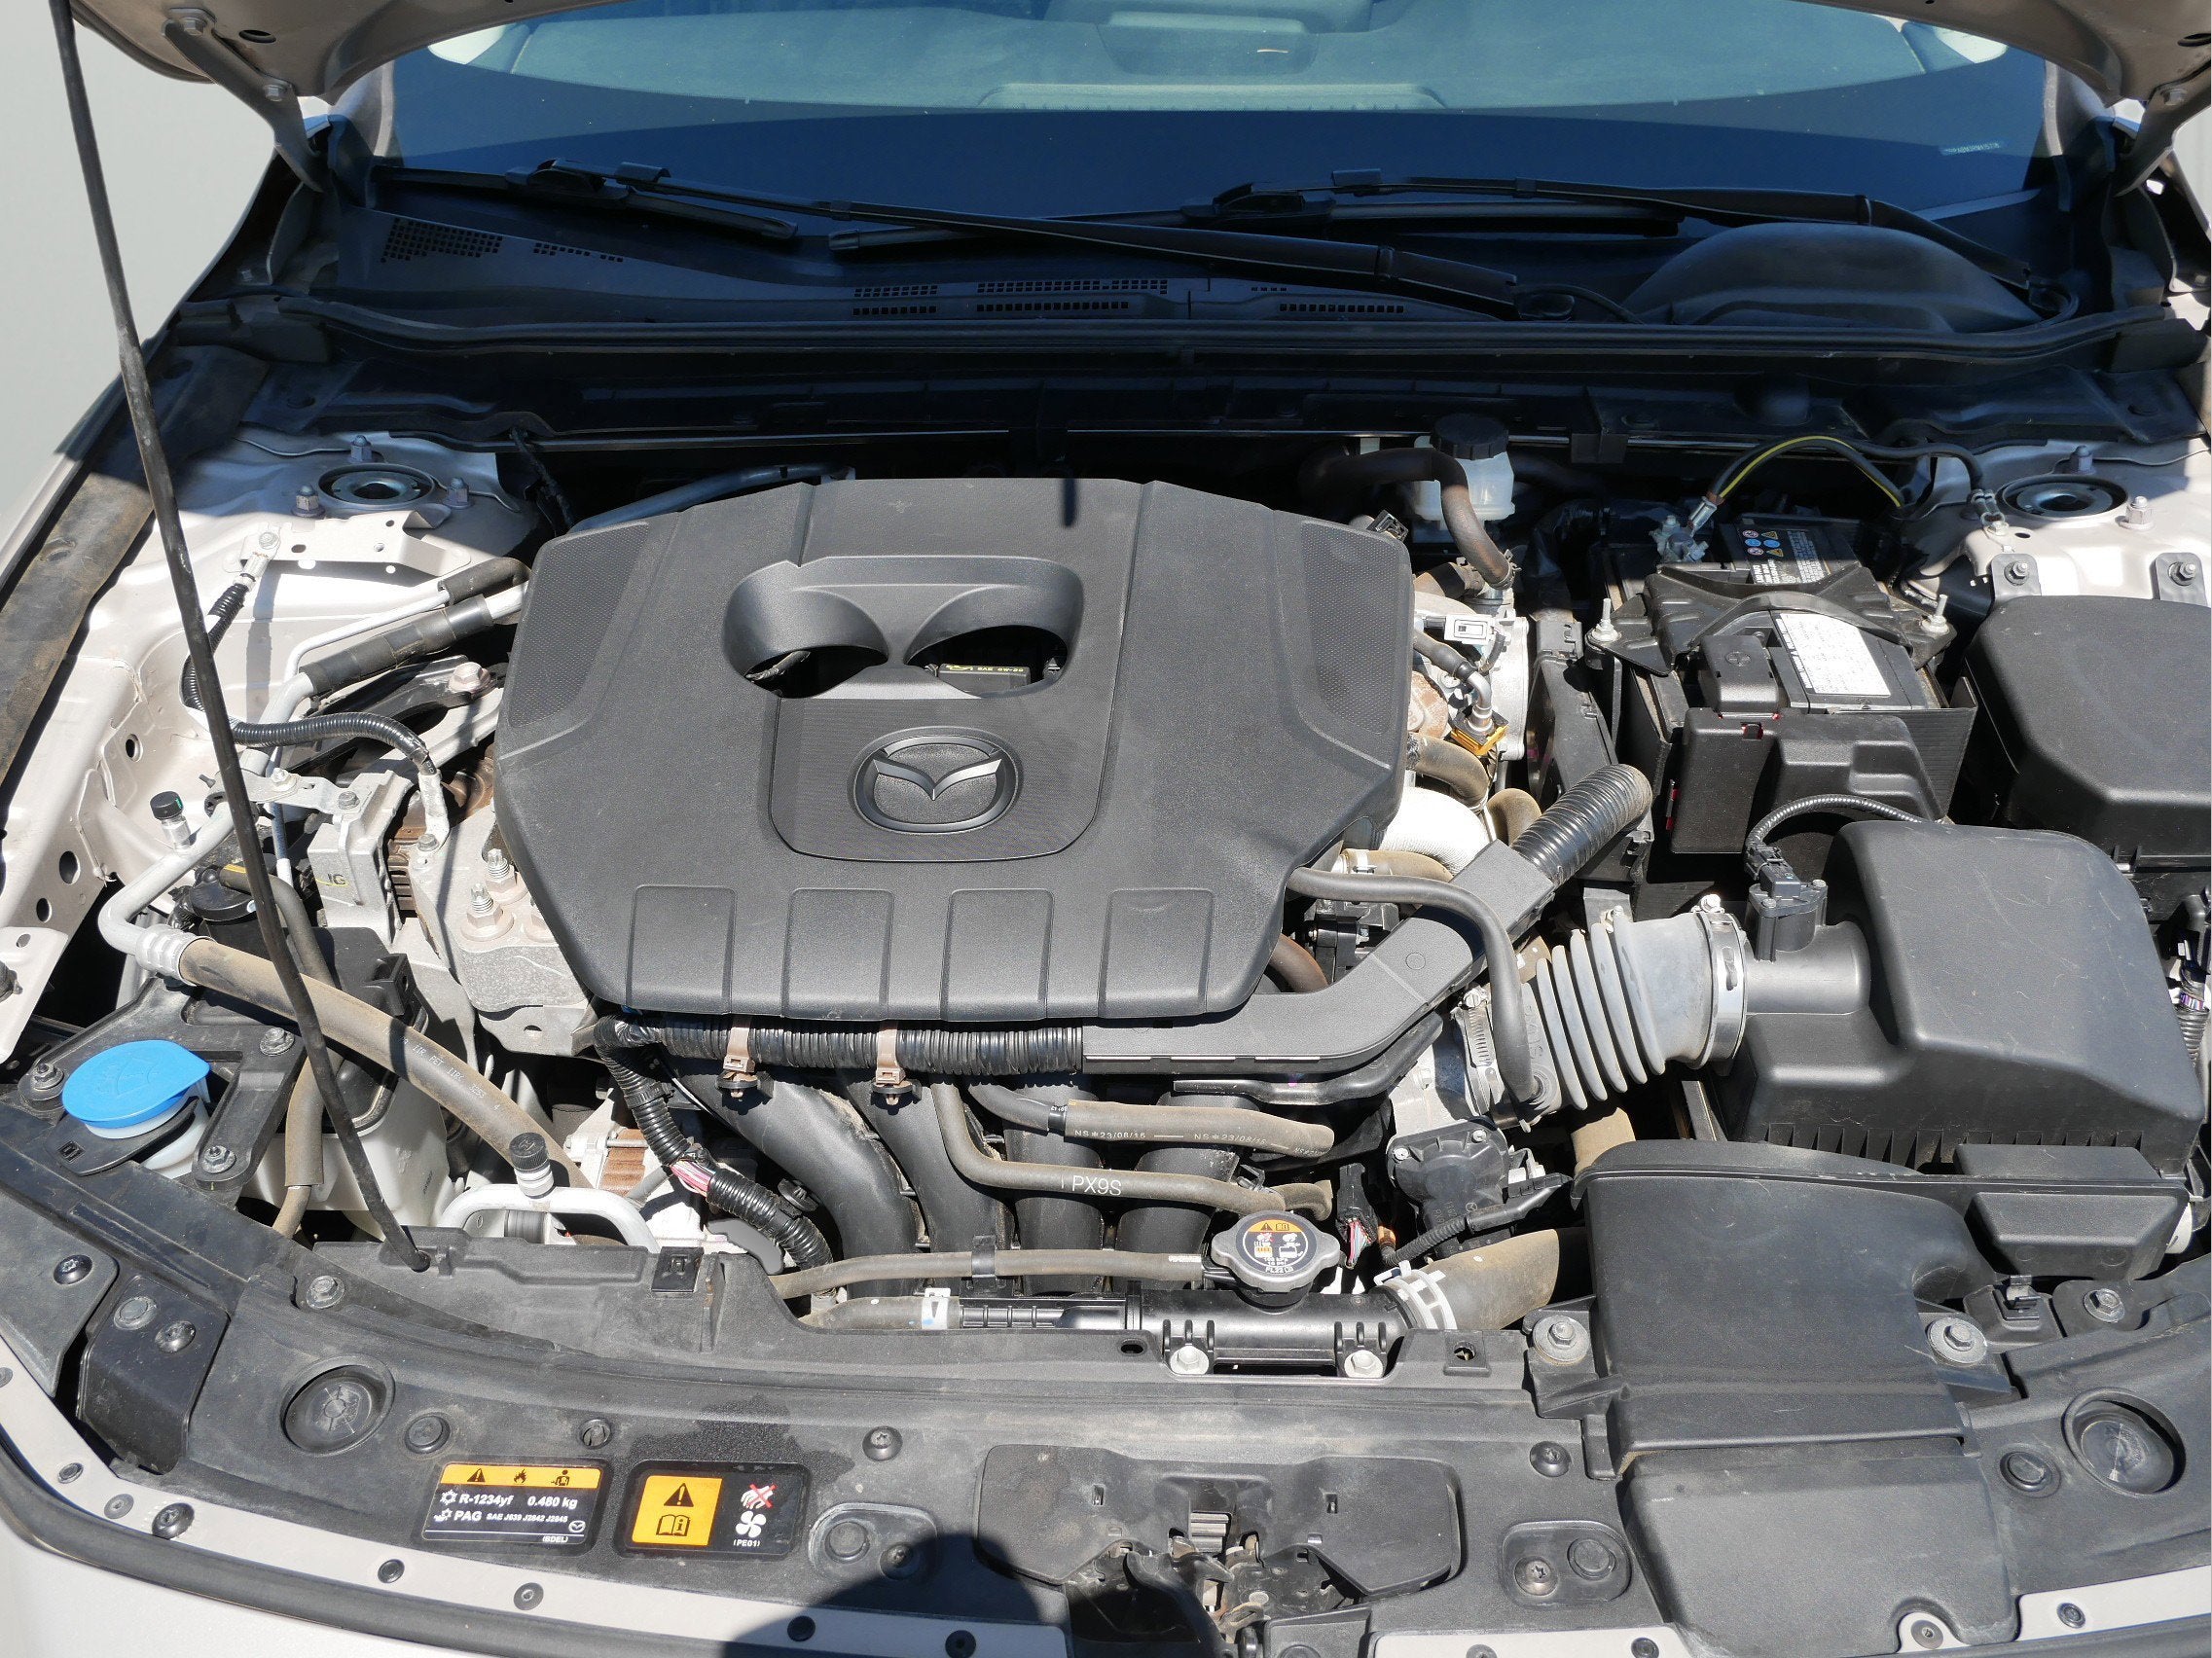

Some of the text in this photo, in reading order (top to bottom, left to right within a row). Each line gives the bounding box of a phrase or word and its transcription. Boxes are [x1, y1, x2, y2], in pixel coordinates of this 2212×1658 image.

[1071, 1174, 1122, 1196] PX9S
[458, 1494, 578, 1509] R-1234yf 0.480 kg
[453, 1510, 483, 1522] PAG
